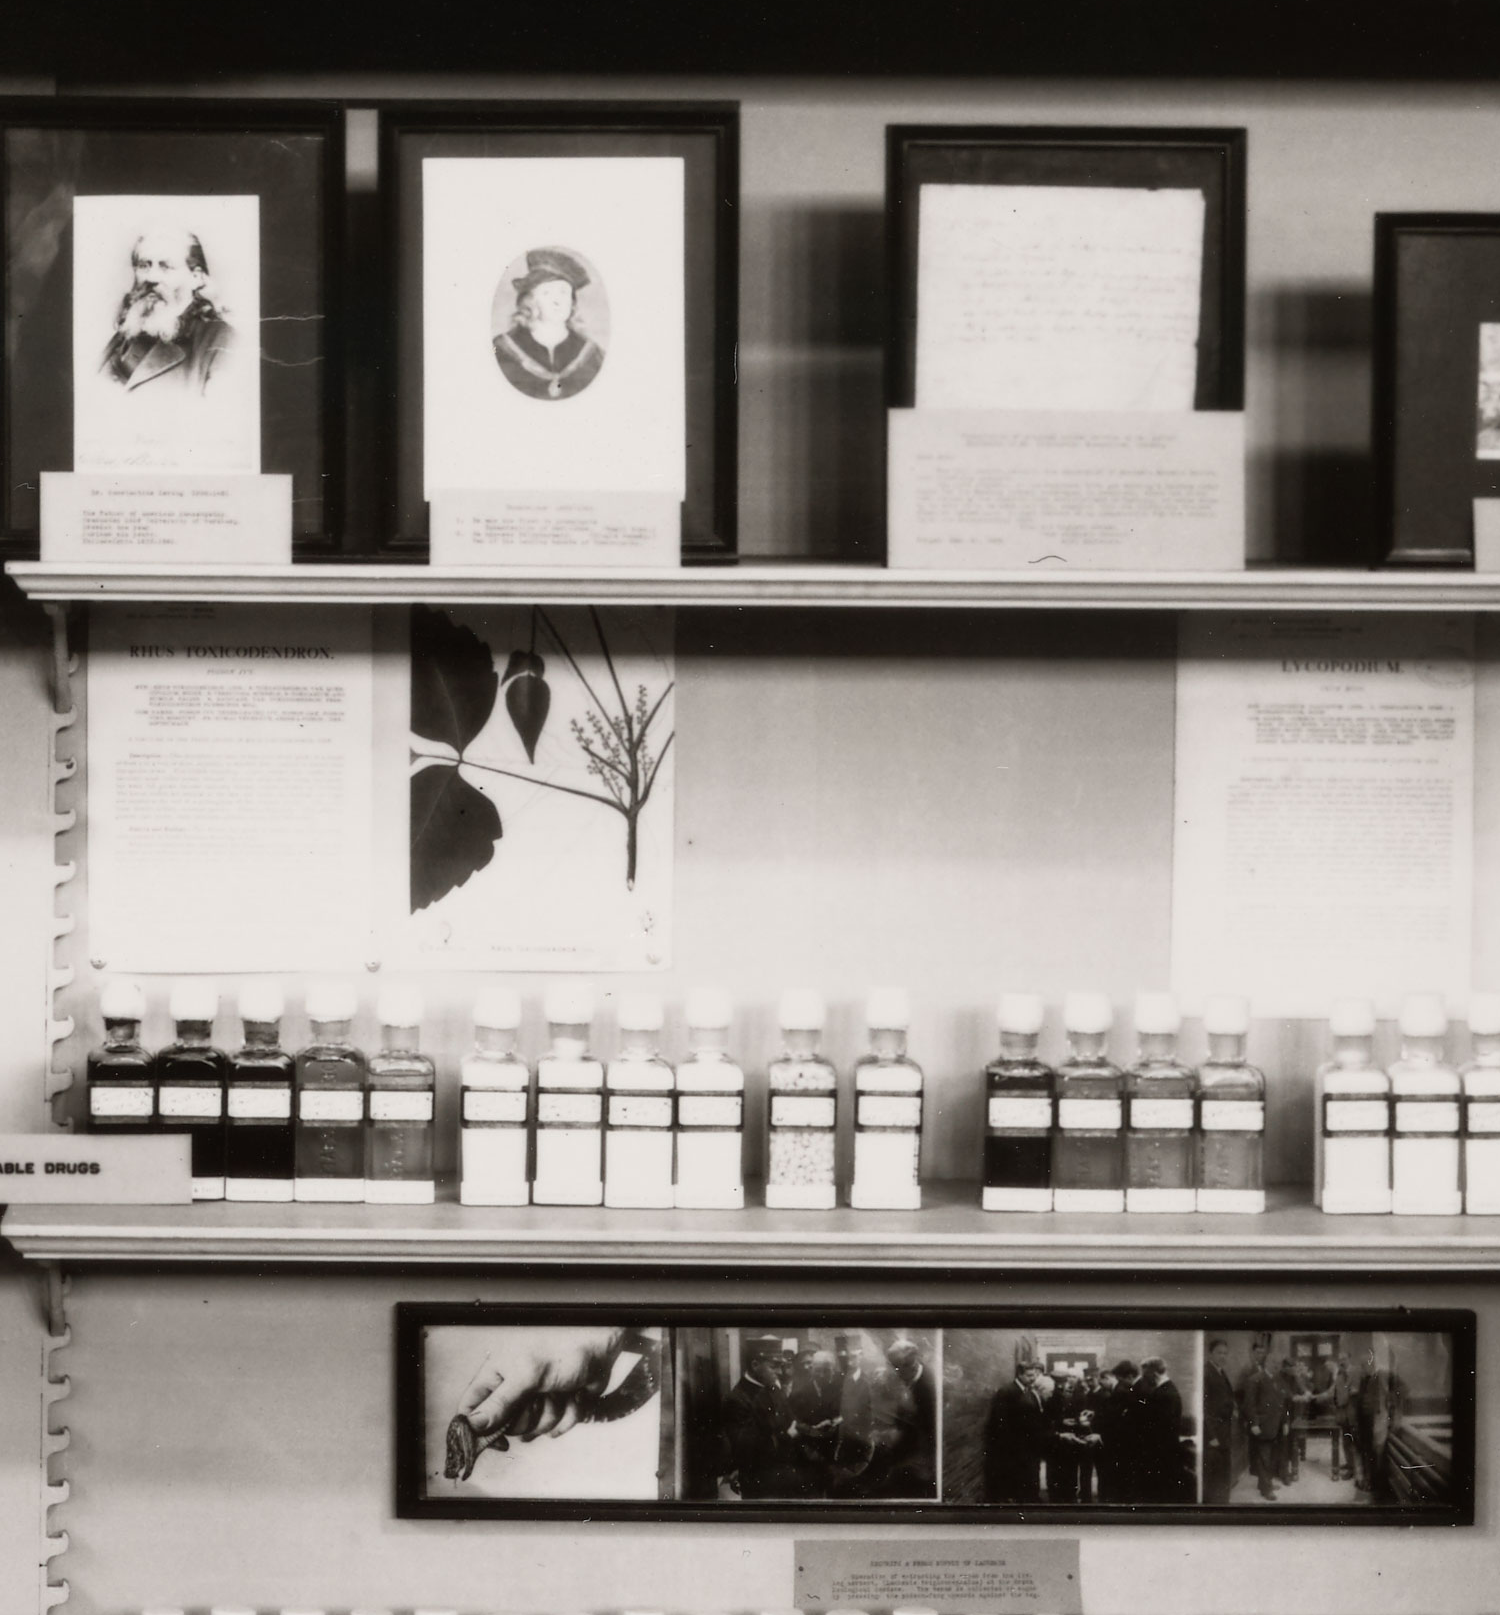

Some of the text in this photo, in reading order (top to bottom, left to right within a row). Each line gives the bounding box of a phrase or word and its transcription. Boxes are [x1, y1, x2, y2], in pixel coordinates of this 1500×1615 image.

[129, 645, 335, 660] RHUS TOXICODENDRON.
[1281, 660, 1405, 674] LYCOPODIUM.
[44, 1161, 101, 1176] DRUGS
